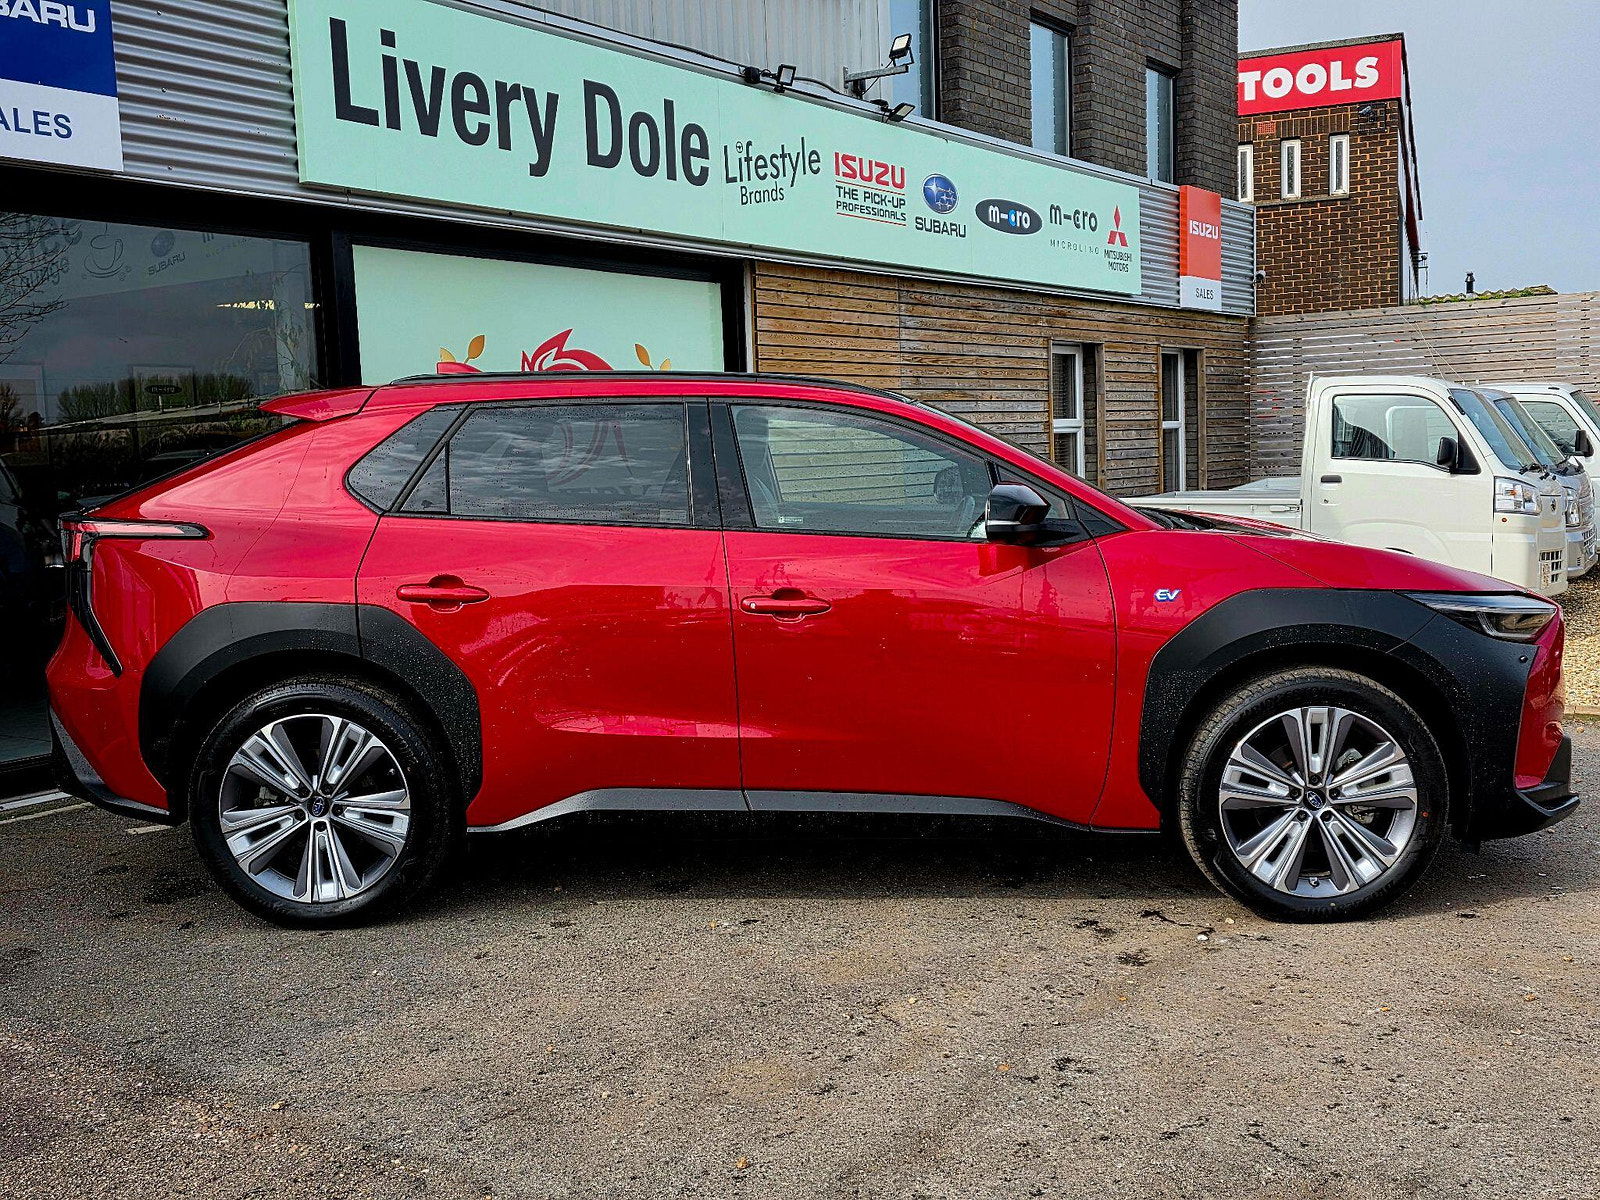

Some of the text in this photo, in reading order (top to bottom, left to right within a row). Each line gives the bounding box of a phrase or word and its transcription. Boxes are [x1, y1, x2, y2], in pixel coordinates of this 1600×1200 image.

[1238, 56, 1379, 101] TOOLS
[329, 16, 710, 187] Livery Dole
[724, 136, 821, 188] Lifestyle
[834, 152, 906, 190] ISUZU
[740, 181, 785, 206] Brands
[835, 185, 906, 210] THE PICK-UP
[836, 200, 907, 222] PROFESSIONALS
[915, 216, 967, 238] SUBARU
[1189, 219, 1219, 239] ISUZU
[147, 252, 187, 276] SUBARU
[1108, 261, 1129, 273] MOTORS
[1195, 288, 1214, 300] SALES
[1154, 588, 1182, 602] EV
